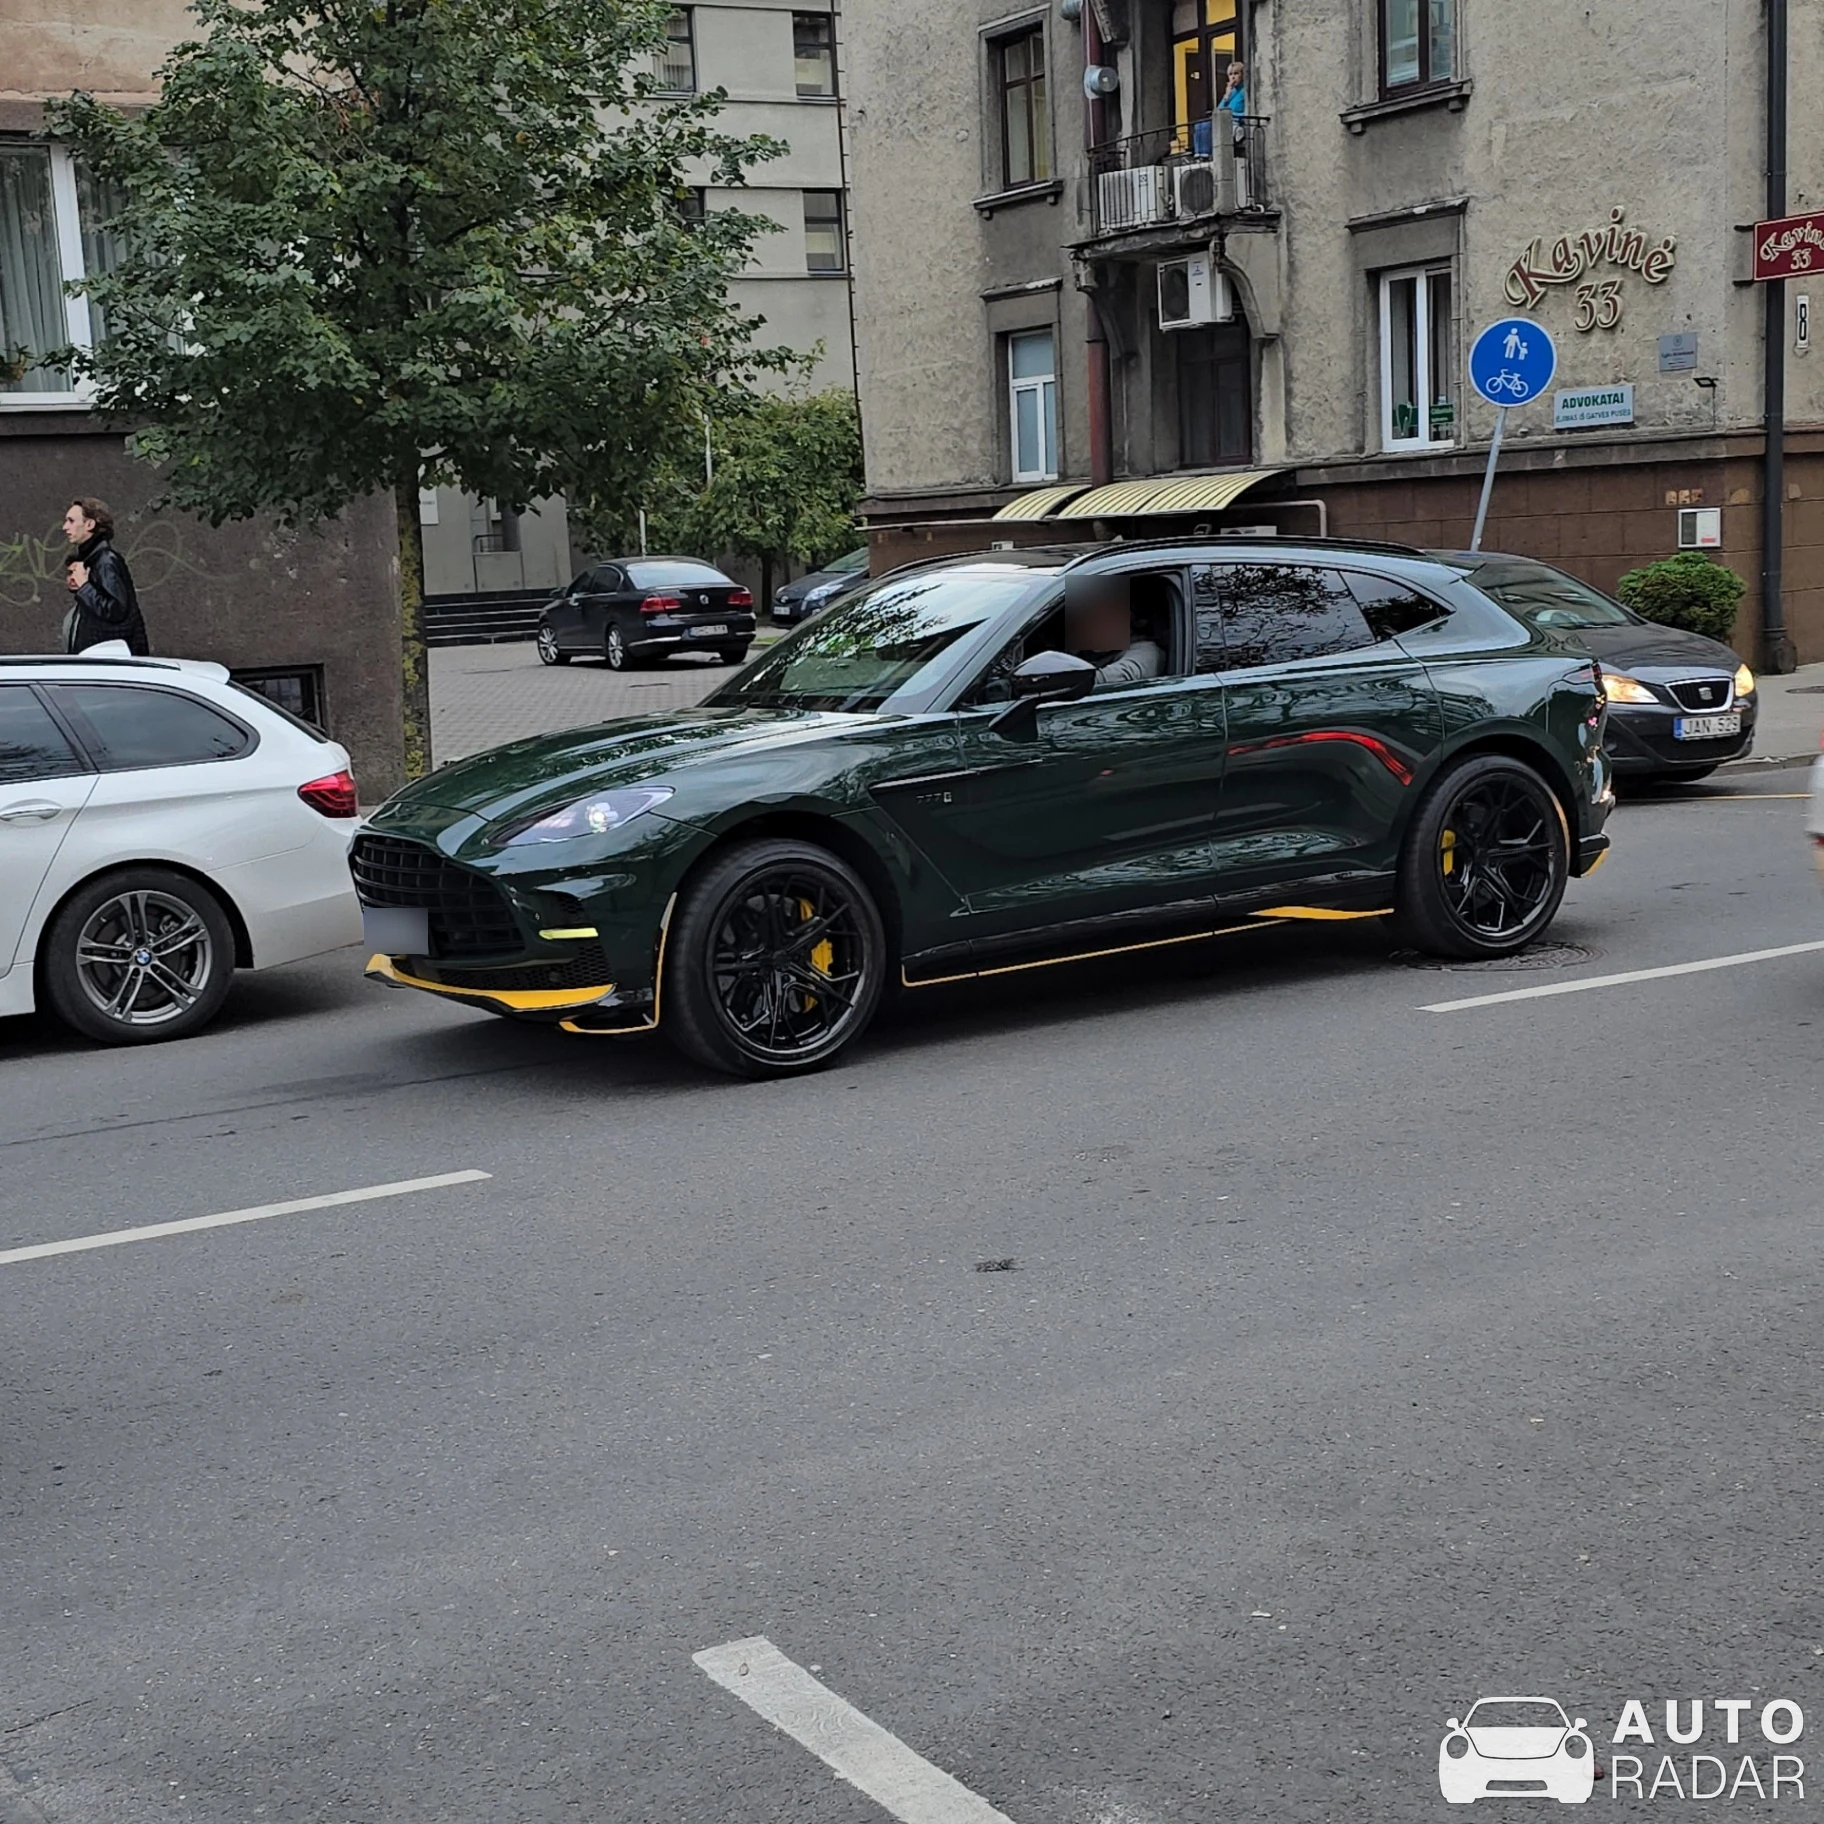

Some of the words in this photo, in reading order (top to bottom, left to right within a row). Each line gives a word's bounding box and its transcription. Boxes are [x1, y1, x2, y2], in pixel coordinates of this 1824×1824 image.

[1504, 205, 1677, 310] Kavinė
[1790, 248, 1812, 270] 33
[1574, 279, 1624, 331] 33
[1562, 392, 1625, 409] ADVOKATAI
[1684, 718, 1711, 734] JAN
